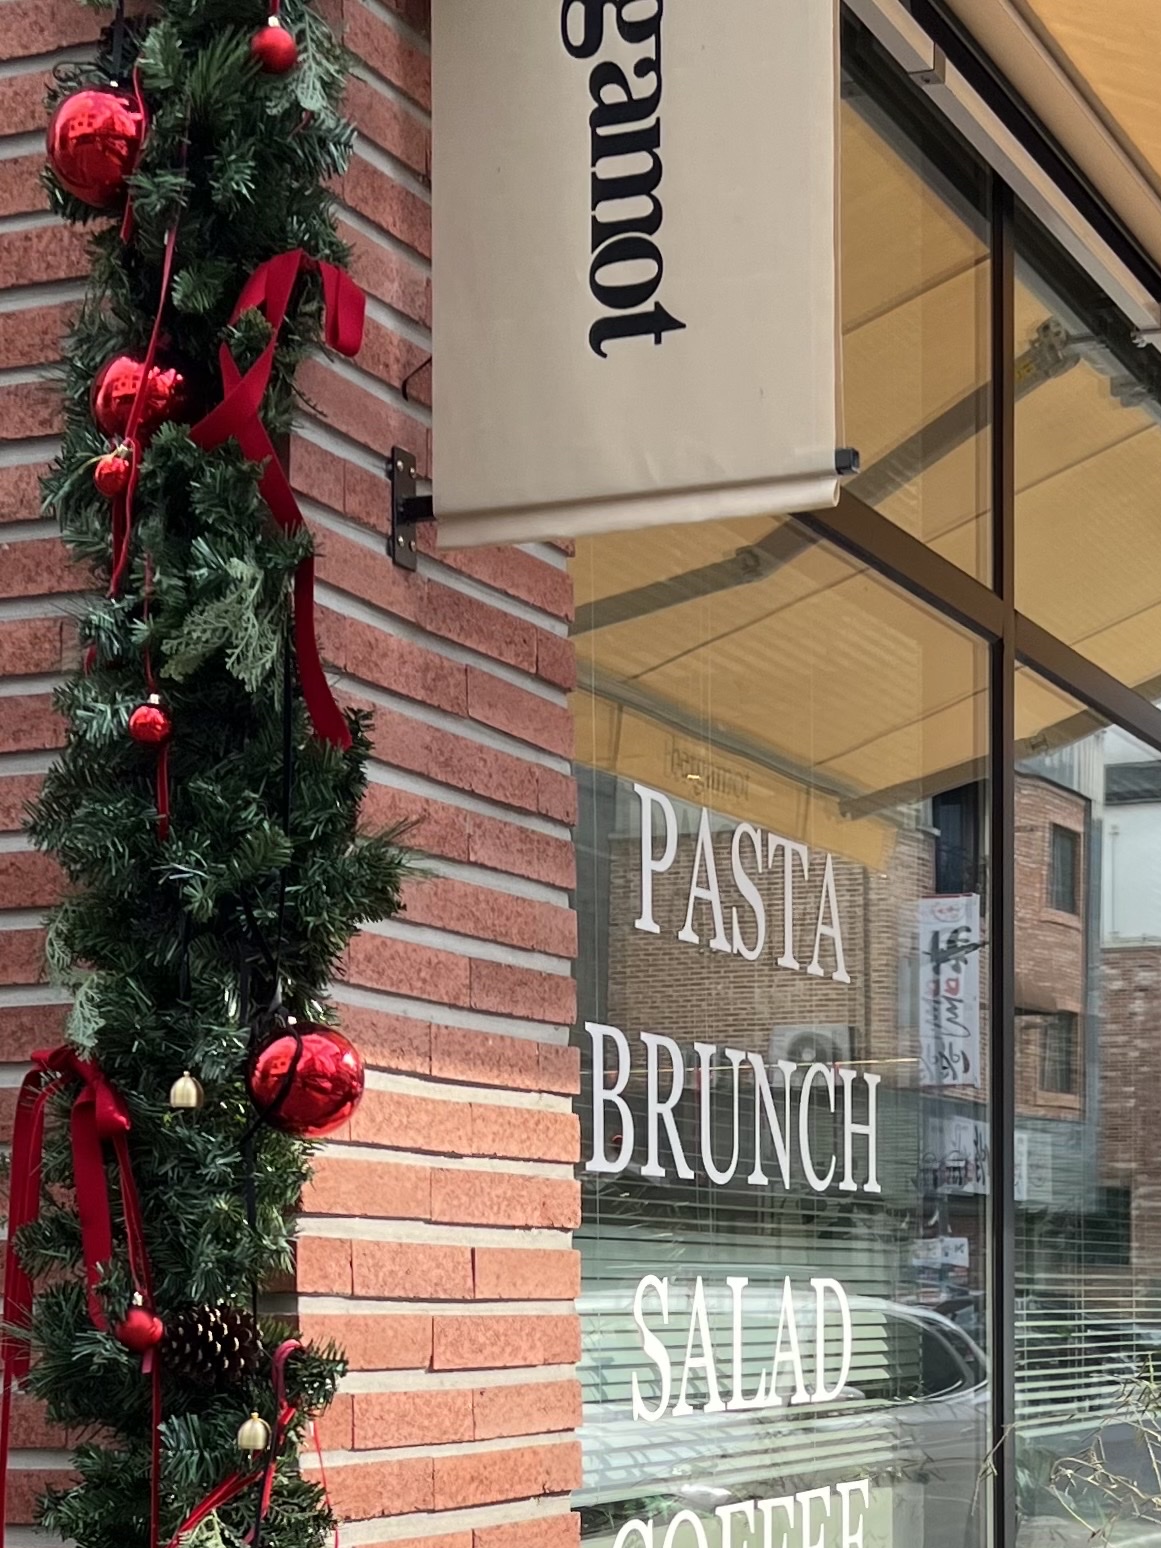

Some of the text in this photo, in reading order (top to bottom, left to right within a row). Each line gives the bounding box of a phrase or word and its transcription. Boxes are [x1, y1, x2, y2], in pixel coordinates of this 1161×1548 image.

[634, 783, 850, 983] PASTA
[585, 1021, 881, 1193] BRUNCH
[633, 1274, 851, 1422] SALAD
